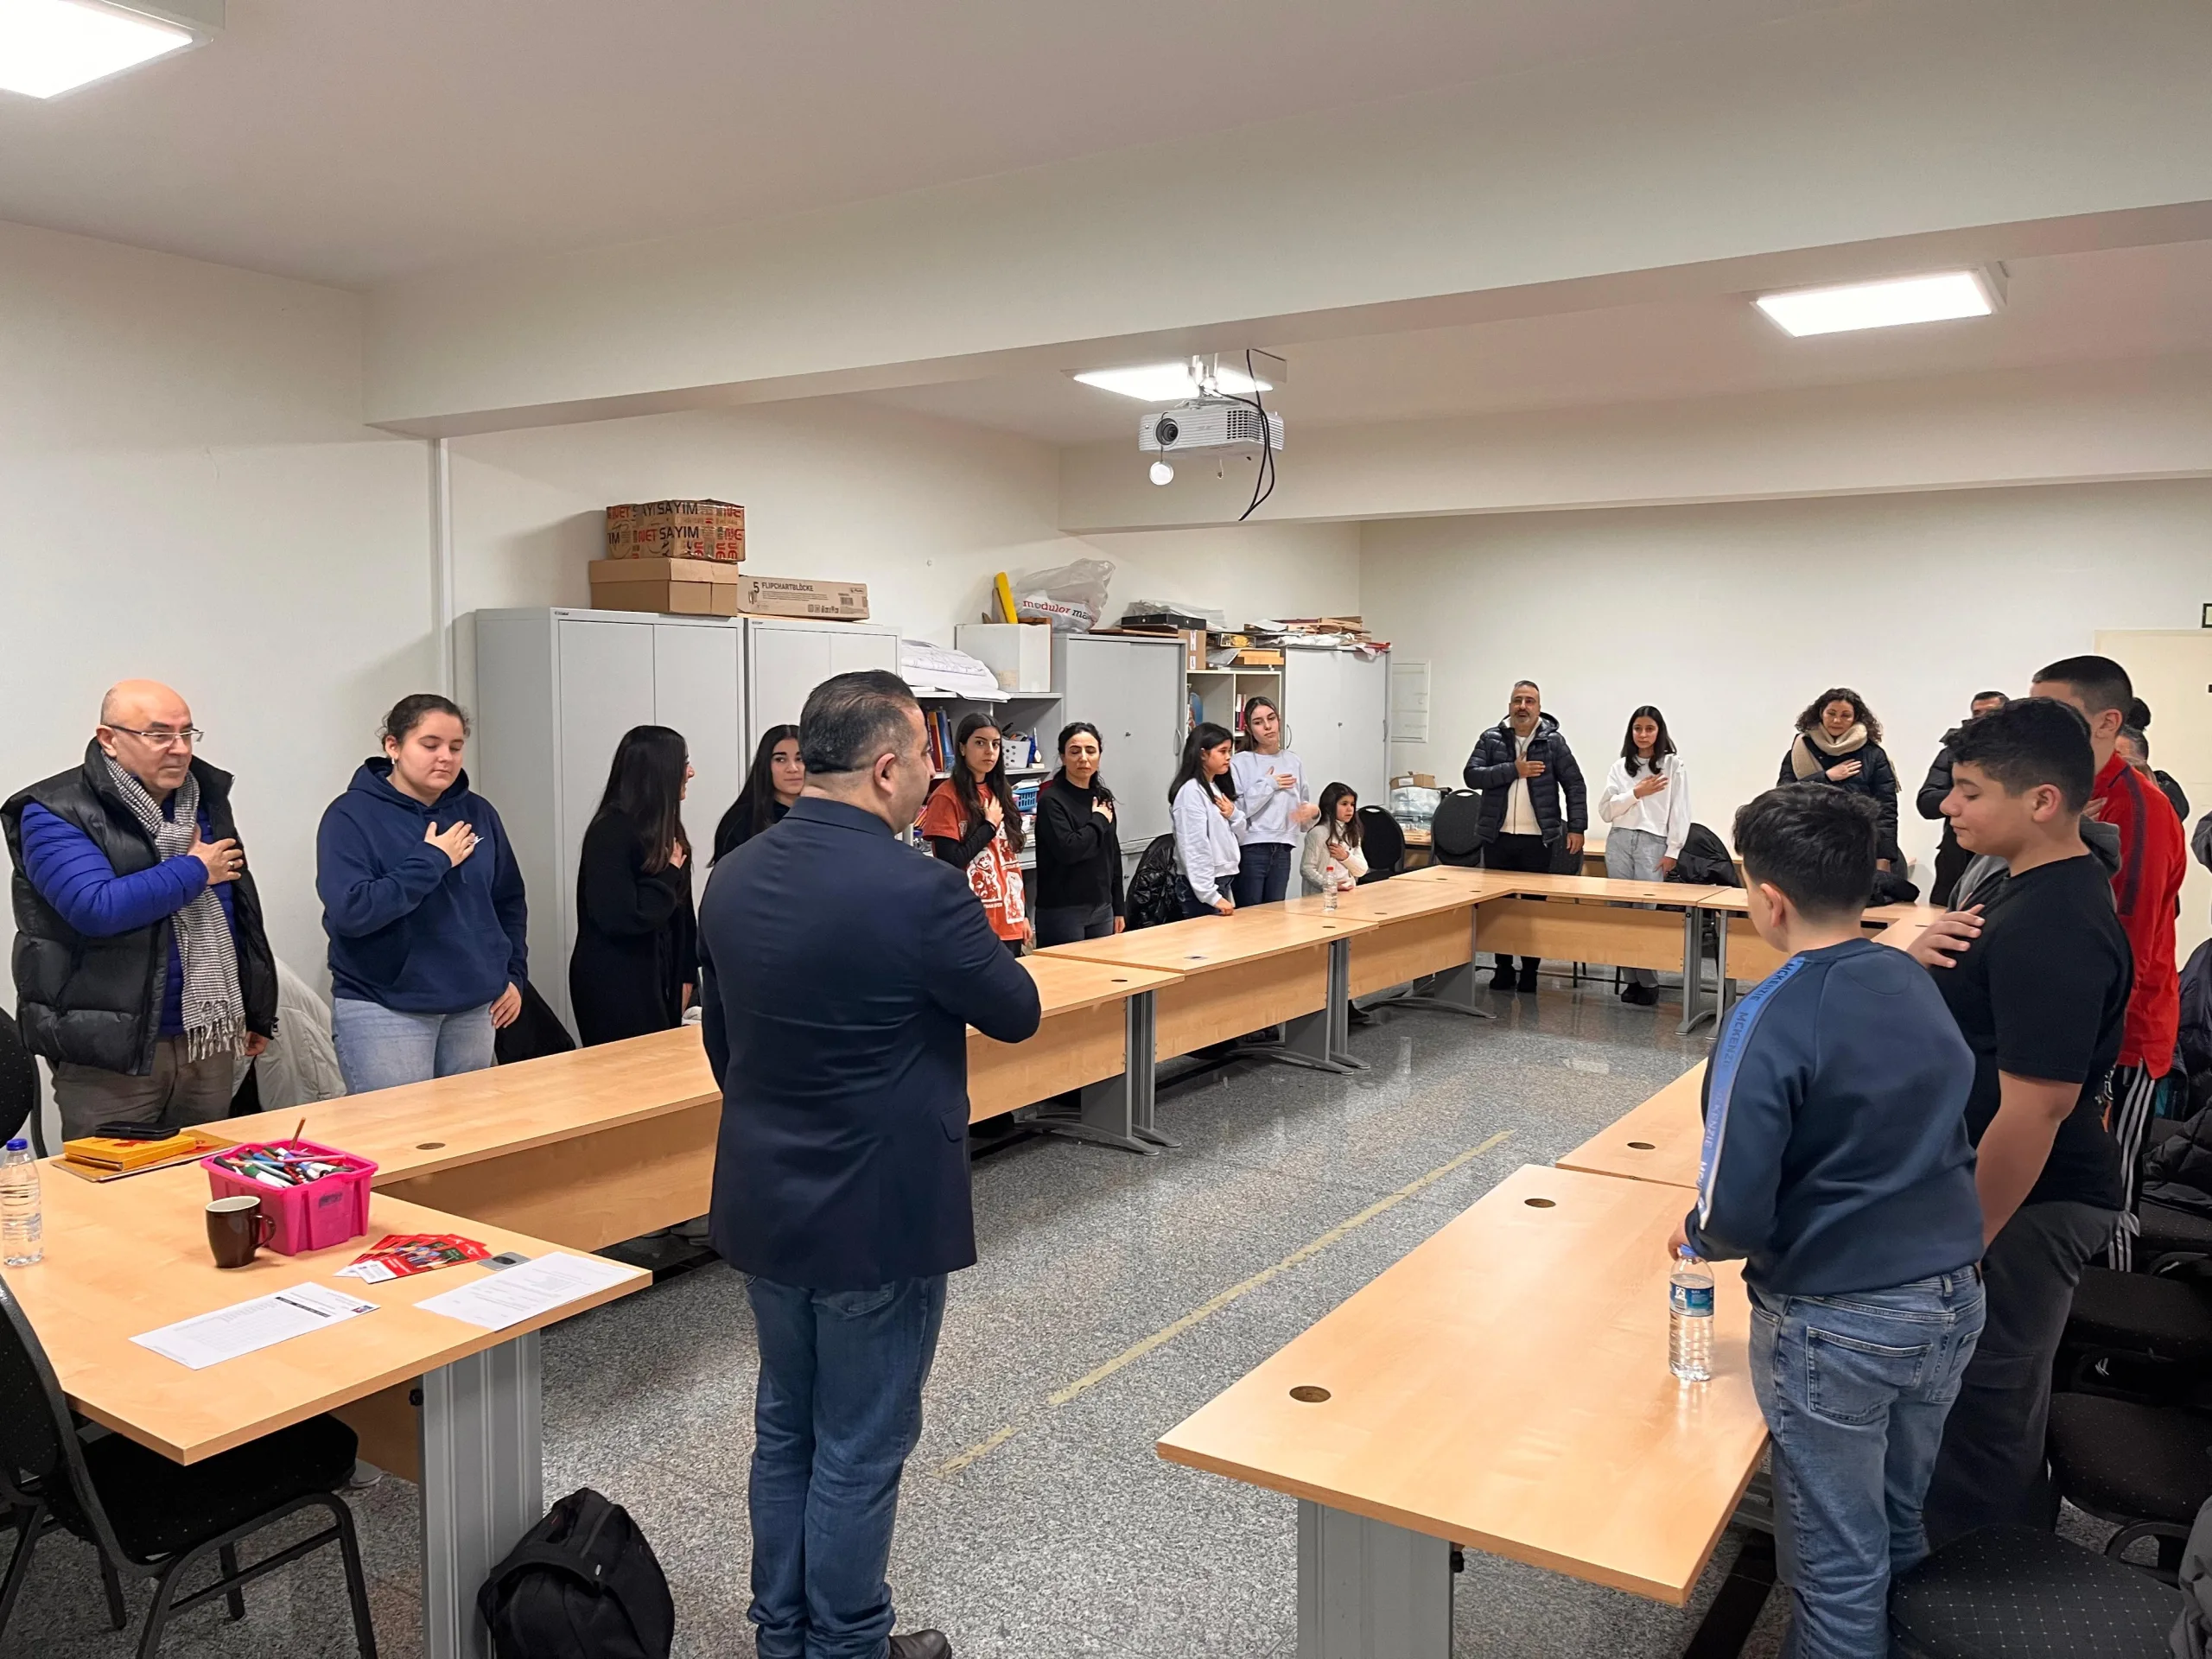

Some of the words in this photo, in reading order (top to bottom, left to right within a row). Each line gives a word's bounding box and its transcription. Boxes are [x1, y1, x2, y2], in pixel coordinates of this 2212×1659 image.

[658, 501, 698, 516] SAYIM
[659, 525, 699, 540] SAYIM
[753, 582, 760, 594] 5
[761, 582, 814, 592] FLIPCHARTBLÖCKE
[1023, 600, 1071, 614] modulor
[1749, 962, 1795, 1002] MCKENZIE
[1722, 1011, 1750, 1068] MCKENZI
